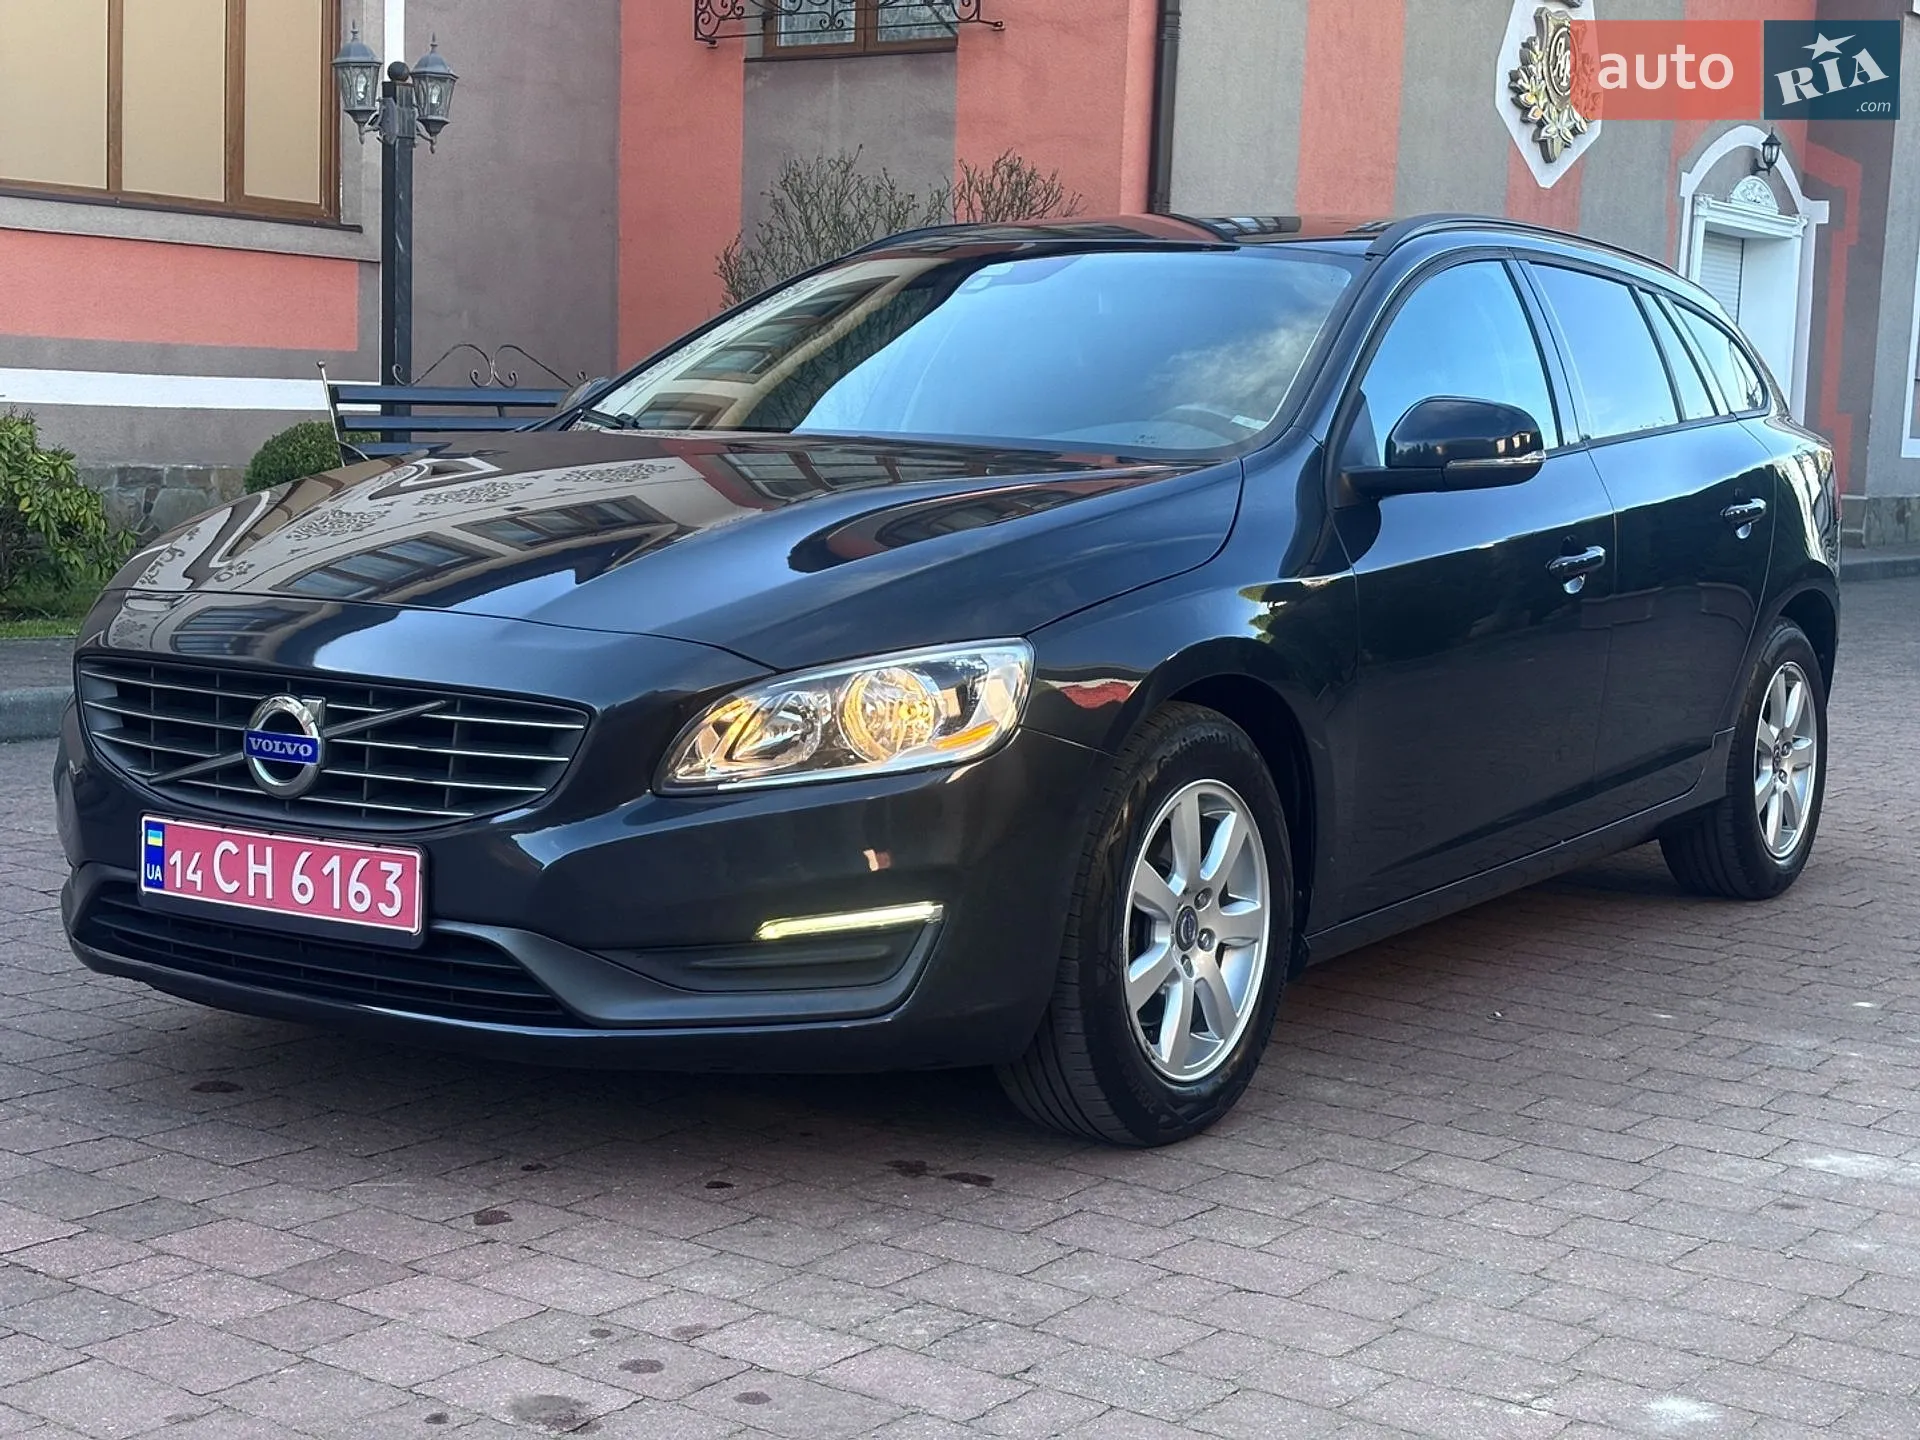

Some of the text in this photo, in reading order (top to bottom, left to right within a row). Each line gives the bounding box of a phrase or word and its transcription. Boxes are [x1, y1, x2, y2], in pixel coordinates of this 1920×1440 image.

[248, 737, 313, 758] VOLVO
[146, 863, 163, 882] UA
[213, 840, 274, 900] CH
[291, 851, 403, 918] 6163
